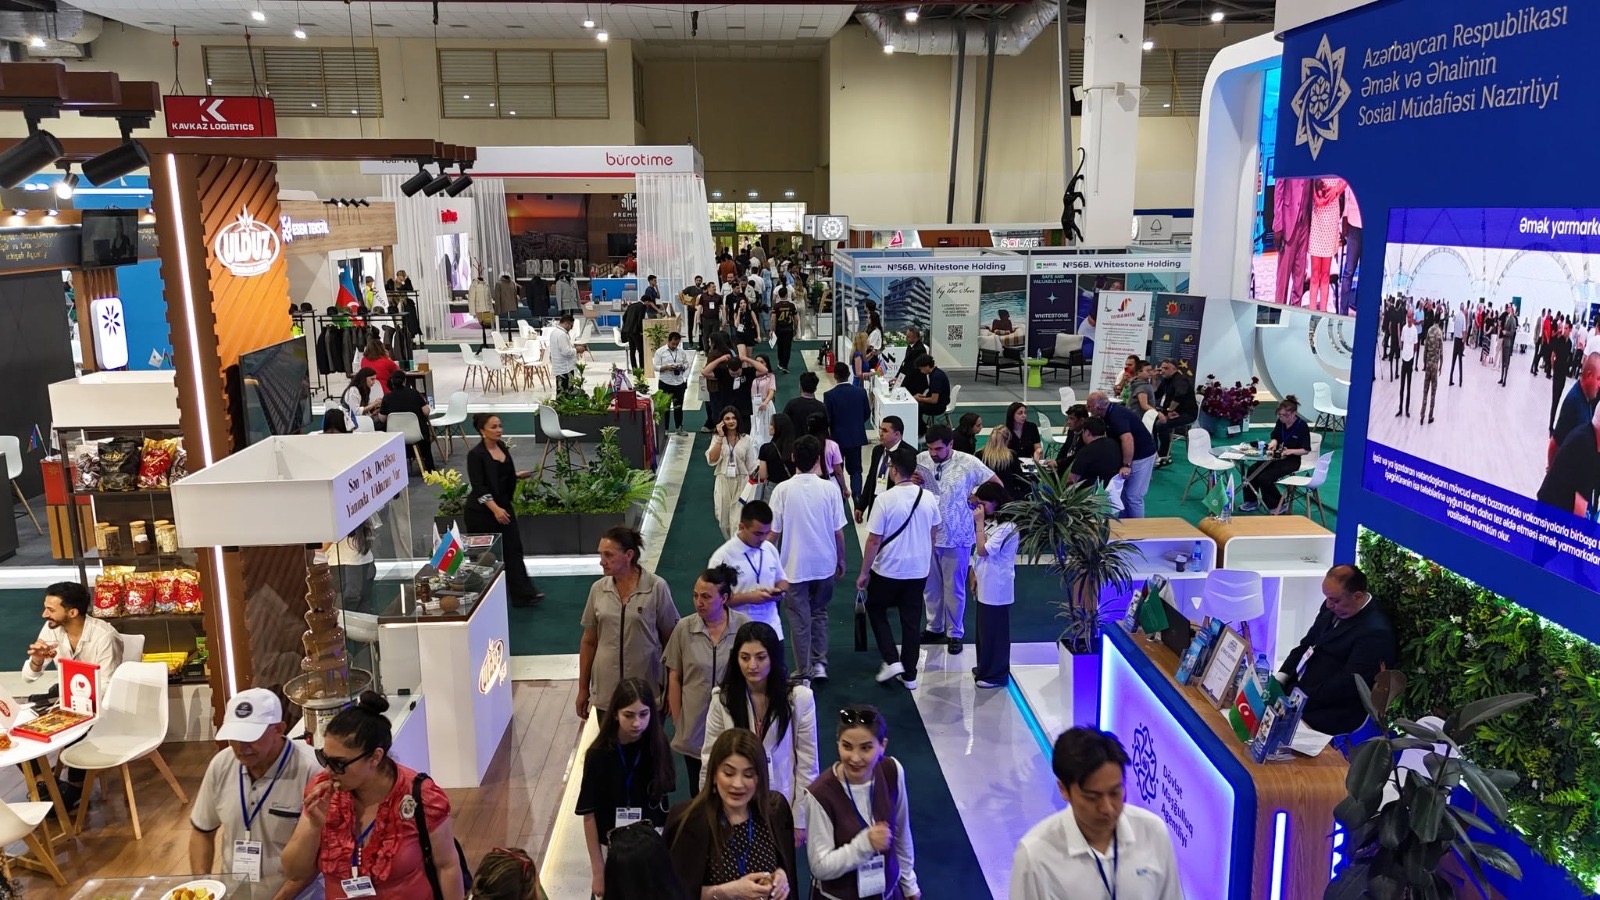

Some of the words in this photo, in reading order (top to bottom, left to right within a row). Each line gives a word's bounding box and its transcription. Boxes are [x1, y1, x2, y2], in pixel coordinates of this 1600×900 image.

[1363, 34, 1447, 69] Azərbaycan
[1453, 6, 1568, 48] Respublikası
[1361, 73, 1400, 98] Əmək
[1404, 71, 1422, 88] və
[1427, 52, 1497, 85] Əhalinin
[1358, 98, 1396, 126] Sosial
[1399, 88, 1475, 121] Müdafiəsi
[1480, 75, 1560, 110] Nazirliyi
[606, 152, 673, 166] bürotime
[1520, 216, 1550, 234] Əmək
[223, 230, 272, 263] ULDUZ
[919, 262, 970, 271] Whitestone
[972, 262, 1006, 271] Holding
[1147, 260, 1182, 268] Holding
[1570, 528, 1597, 549] birbaşa
[1163, 764, 1182, 800] Dövlət
[1161, 803, 1188, 848] Agentliyi
[1162, 782, 1193, 838] Məşğulluq
